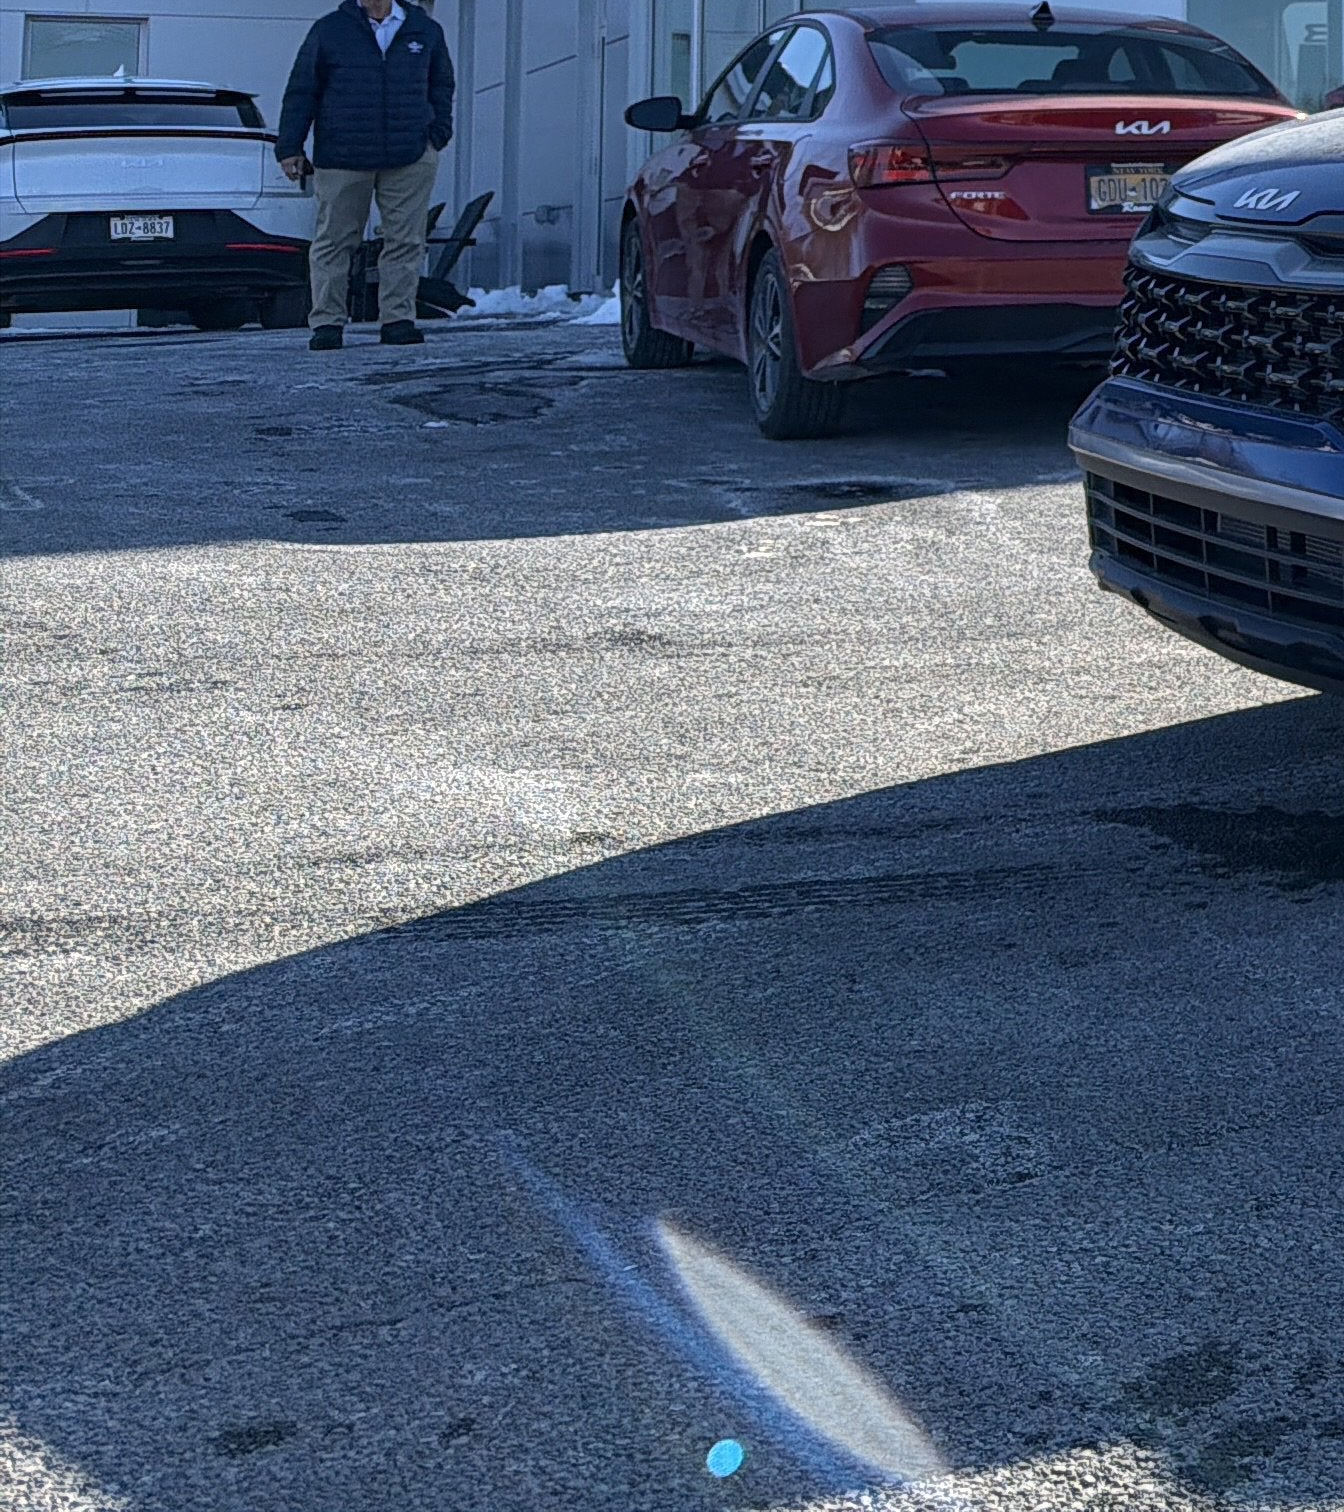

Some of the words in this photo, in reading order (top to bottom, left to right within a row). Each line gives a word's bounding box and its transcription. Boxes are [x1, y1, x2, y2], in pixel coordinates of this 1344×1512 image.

[1115, 120, 1171, 135] KIA
[950, 191, 1006, 200] FORTE
[1233, 187, 1302, 212] KIA
